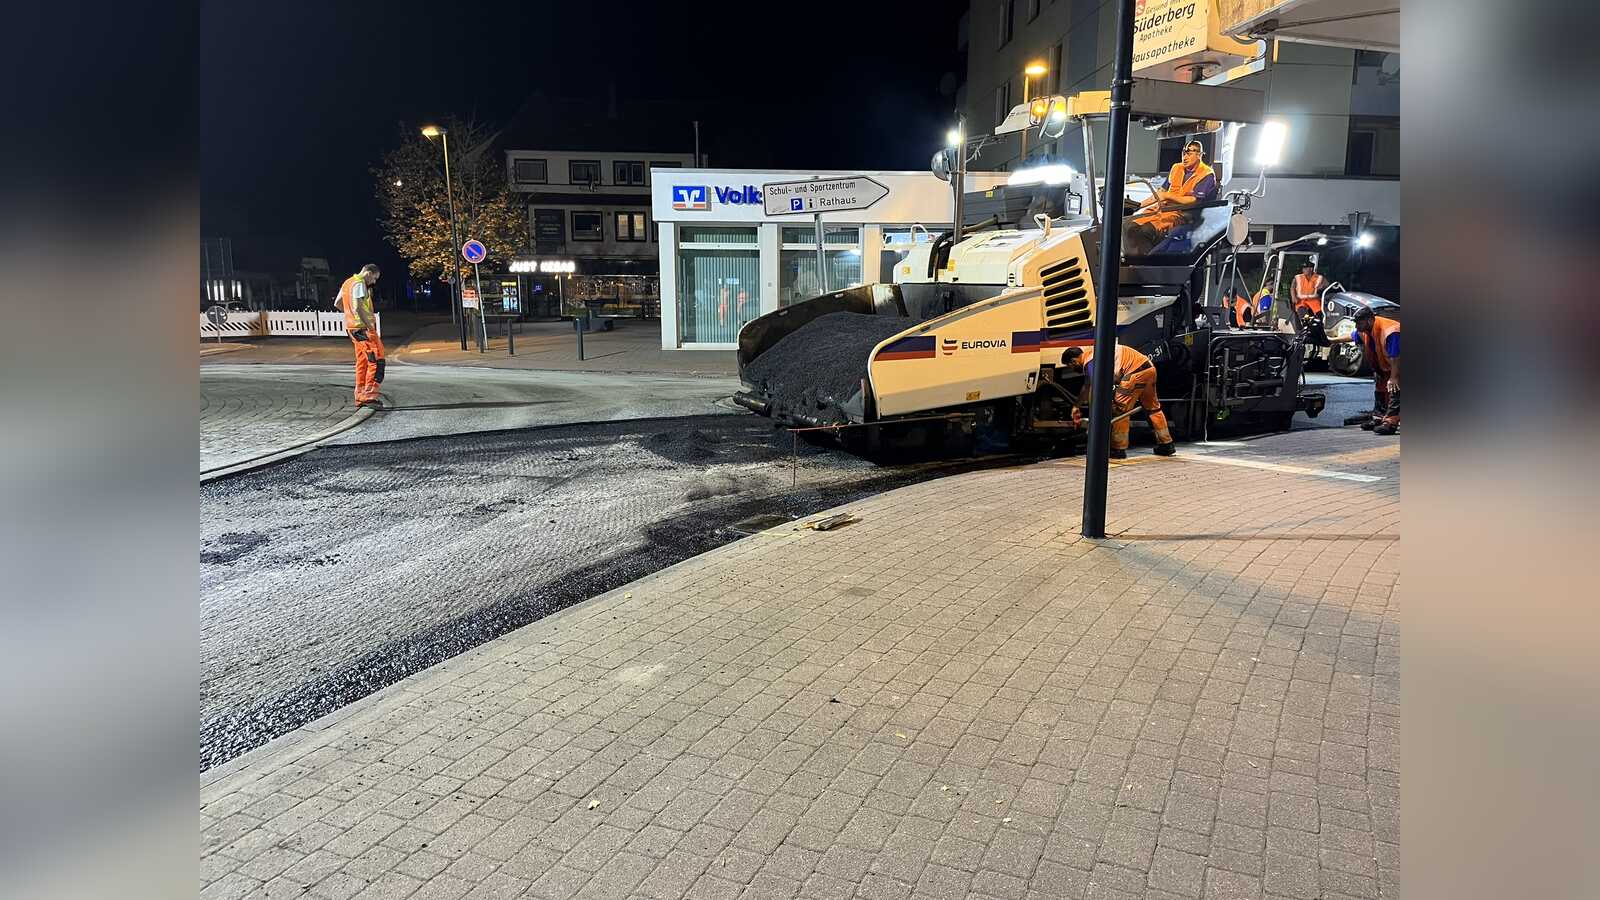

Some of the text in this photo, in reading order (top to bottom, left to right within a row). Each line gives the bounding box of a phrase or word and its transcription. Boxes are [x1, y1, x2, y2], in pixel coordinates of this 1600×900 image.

[1134, 3, 1195, 33] Süderberg
[1140, 25, 1173, 43] Apotheke
[714, 185, 763, 204] Volk
[769, 186, 792, 195] Schul-
[810, 181, 855, 192] Sportzentrum
[820, 196, 856, 207] Rathaus
[961, 340, 1007, 349] EUROVIA
